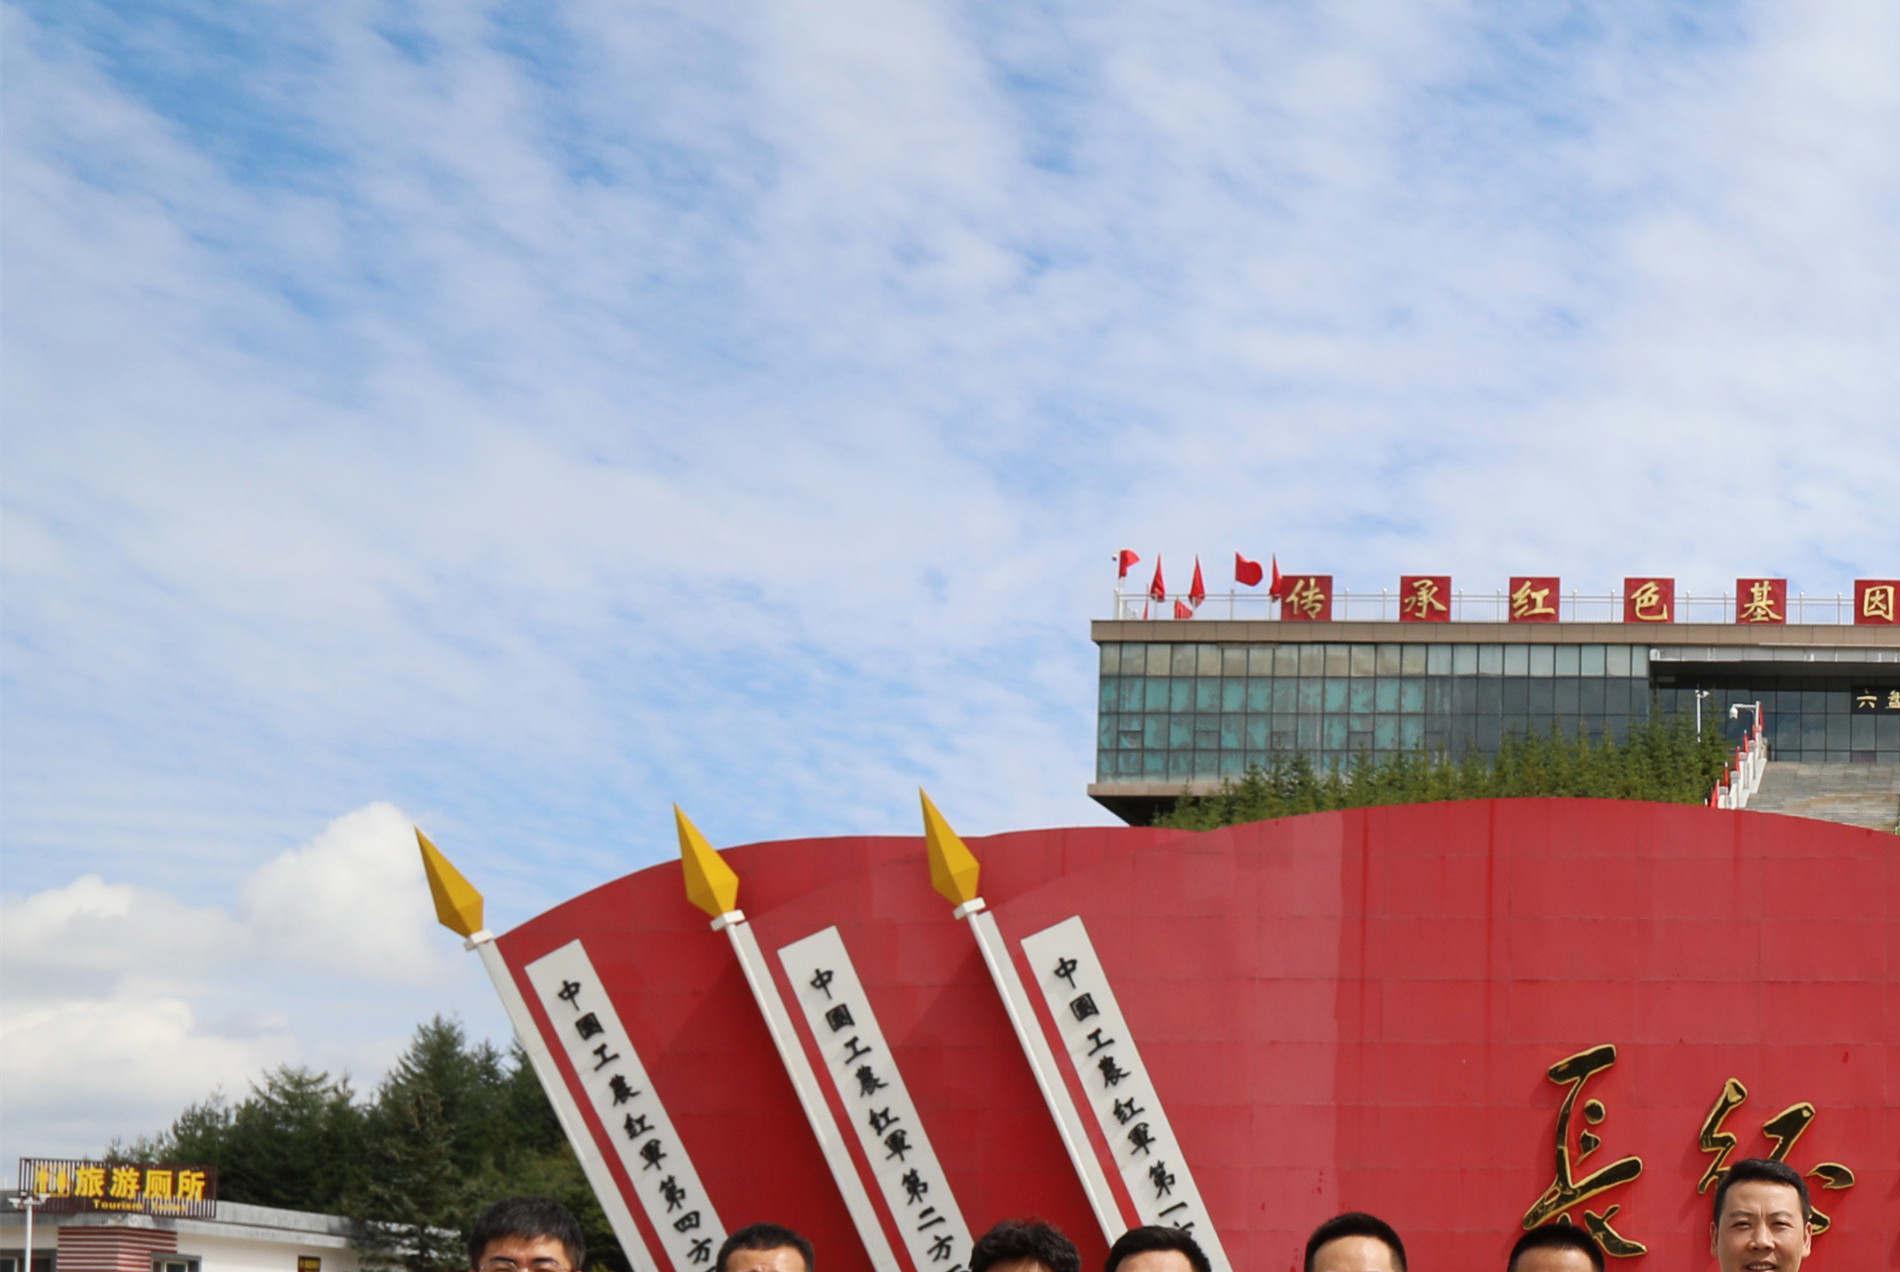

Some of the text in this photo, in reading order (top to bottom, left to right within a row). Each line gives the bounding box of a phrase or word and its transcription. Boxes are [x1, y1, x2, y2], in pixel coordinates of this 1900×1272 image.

[1285, 578, 1897, 622] 传承红色基因
[74, 1166, 206, 1201] 旅游厕所
